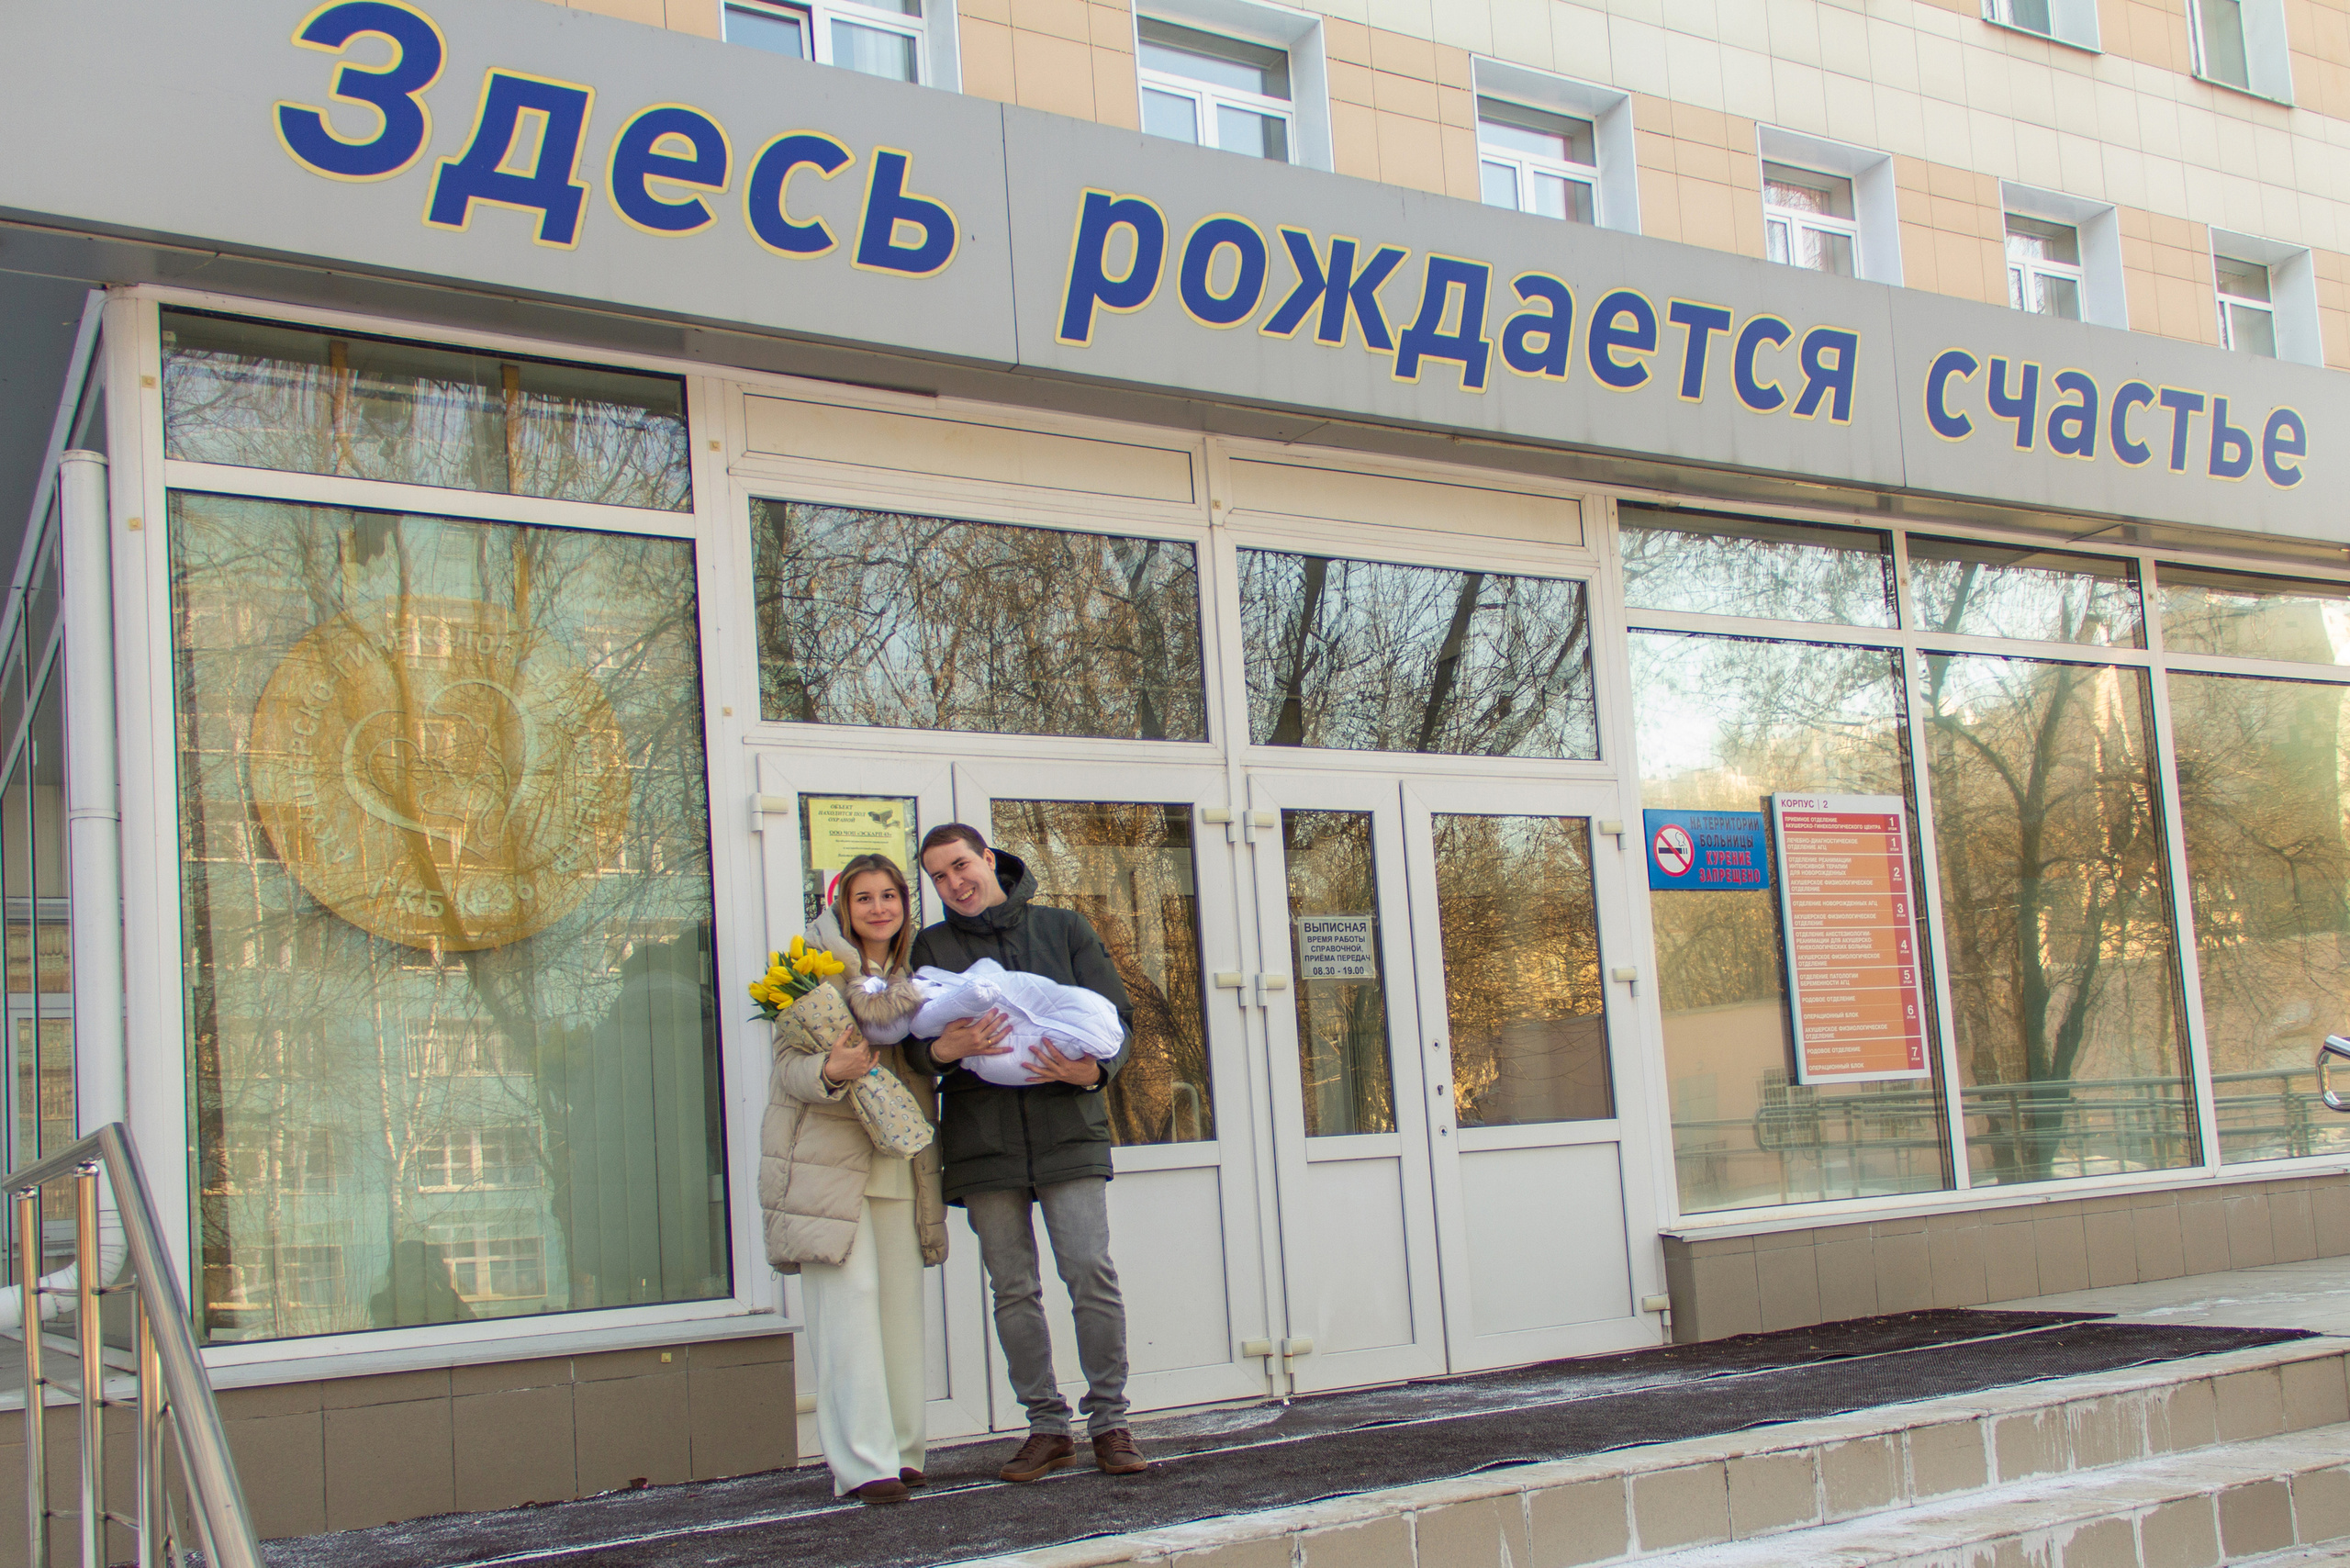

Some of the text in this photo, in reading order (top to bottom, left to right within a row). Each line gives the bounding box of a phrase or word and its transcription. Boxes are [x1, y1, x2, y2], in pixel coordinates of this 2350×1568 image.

[273, 0, 2309, 491] Здесь рождается счастье
[1781, 800, 1814, 808] КОРПУС
[1690, 817, 1759, 831] НА ТЕРРИТОРИИ
[1889, 817, 1894, 826] 1
[1700, 834, 1753, 850] БОЛЬНИЦЫ
[1891, 838, 1897, 847] 1
[1707, 851, 1751, 866] КУРЕНИЕ
[1699, 868, 1761, 885] ЗАПРЕЩЕНО
[1894, 868, 1900, 877] 2
[1897, 903, 1903, 913] 3
[1304, 923, 1367, 933] ВЫПИСНАЯ
[1311, 944, 1364, 953] СПРАВОЧНОЙ,
[1901, 940, 1908, 949] 4
[1304, 954, 1336, 962] ПРИЁМА
[1313, 967, 1335, 975] 08.30
[1344, 966, 1364, 975] 19.00
[1904, 970, 1910, 980] 5
[1908, 1005, 1914, 1014] 6
[1911, 1047, 1918, 1057] 7
[1808, 1063, 1850, 1071] ОПЕРАЦИОННЫЙ
